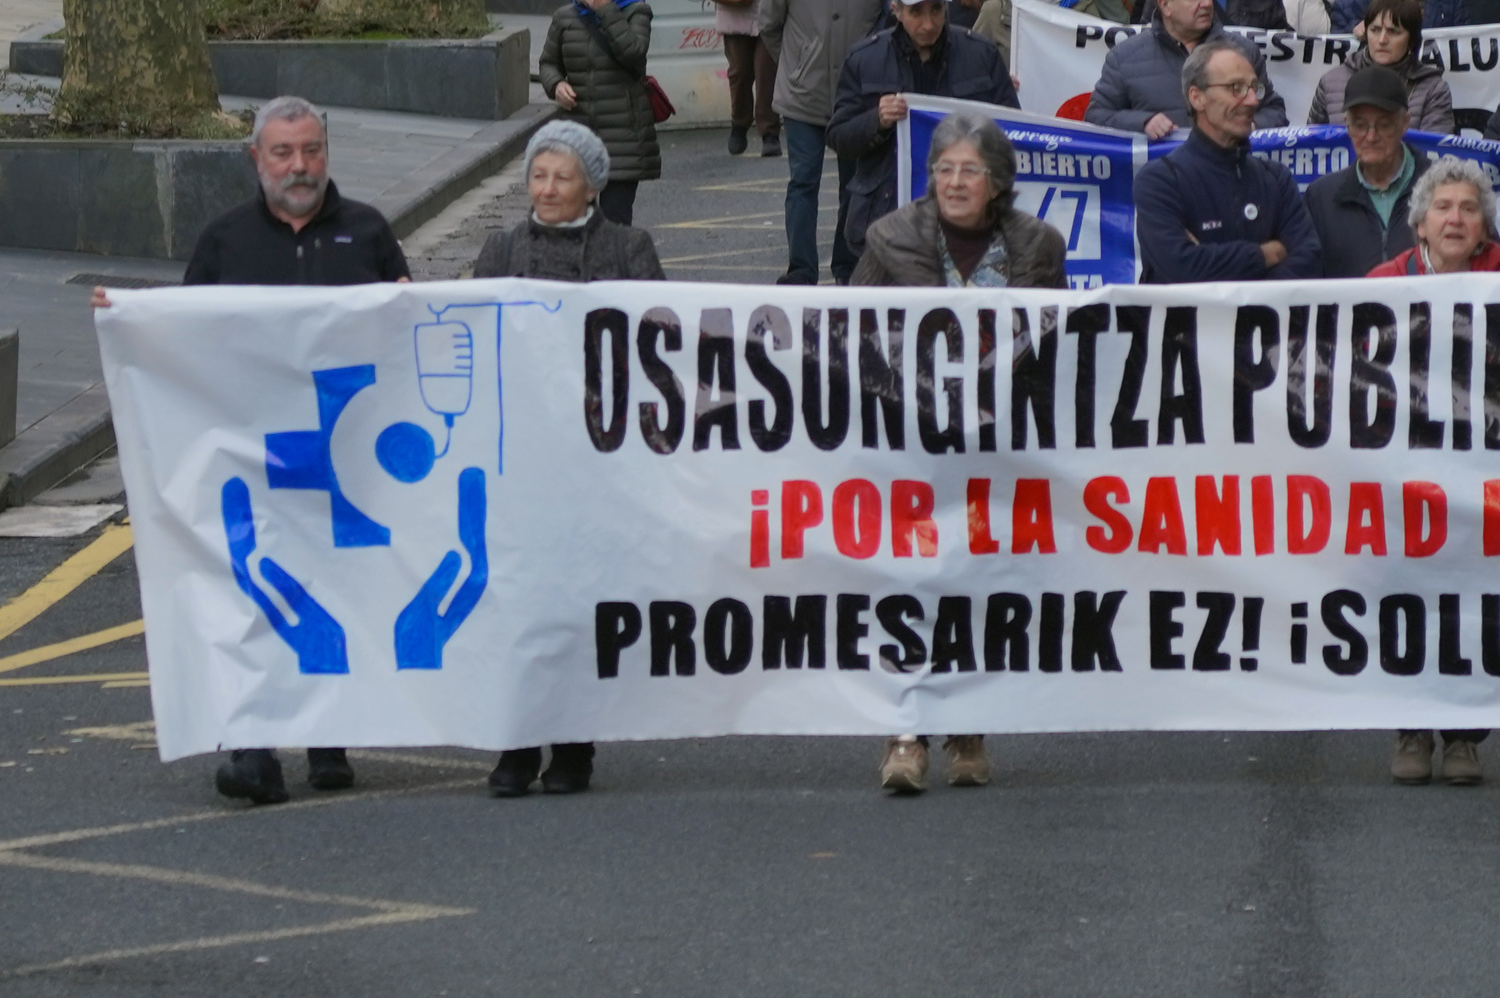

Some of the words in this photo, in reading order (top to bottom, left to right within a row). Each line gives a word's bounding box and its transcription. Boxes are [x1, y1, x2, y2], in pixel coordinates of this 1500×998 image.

[1076, 24, 1151, 50] PO
[1016, 150, 1111, 180] BIERTO
[1036, 187, 1089, 252] /7
[585, 303, 1205, 454] OSASUNGINTZA
[750, 478, 938, 568] ¡POR
[966, 477, 1057, 555] LA
[1082, 475, 1449, 558] SANIDAD
[595, 590, 1128, 679] PROMESARIK
[1149, 590, 1265, 672] EZ!
